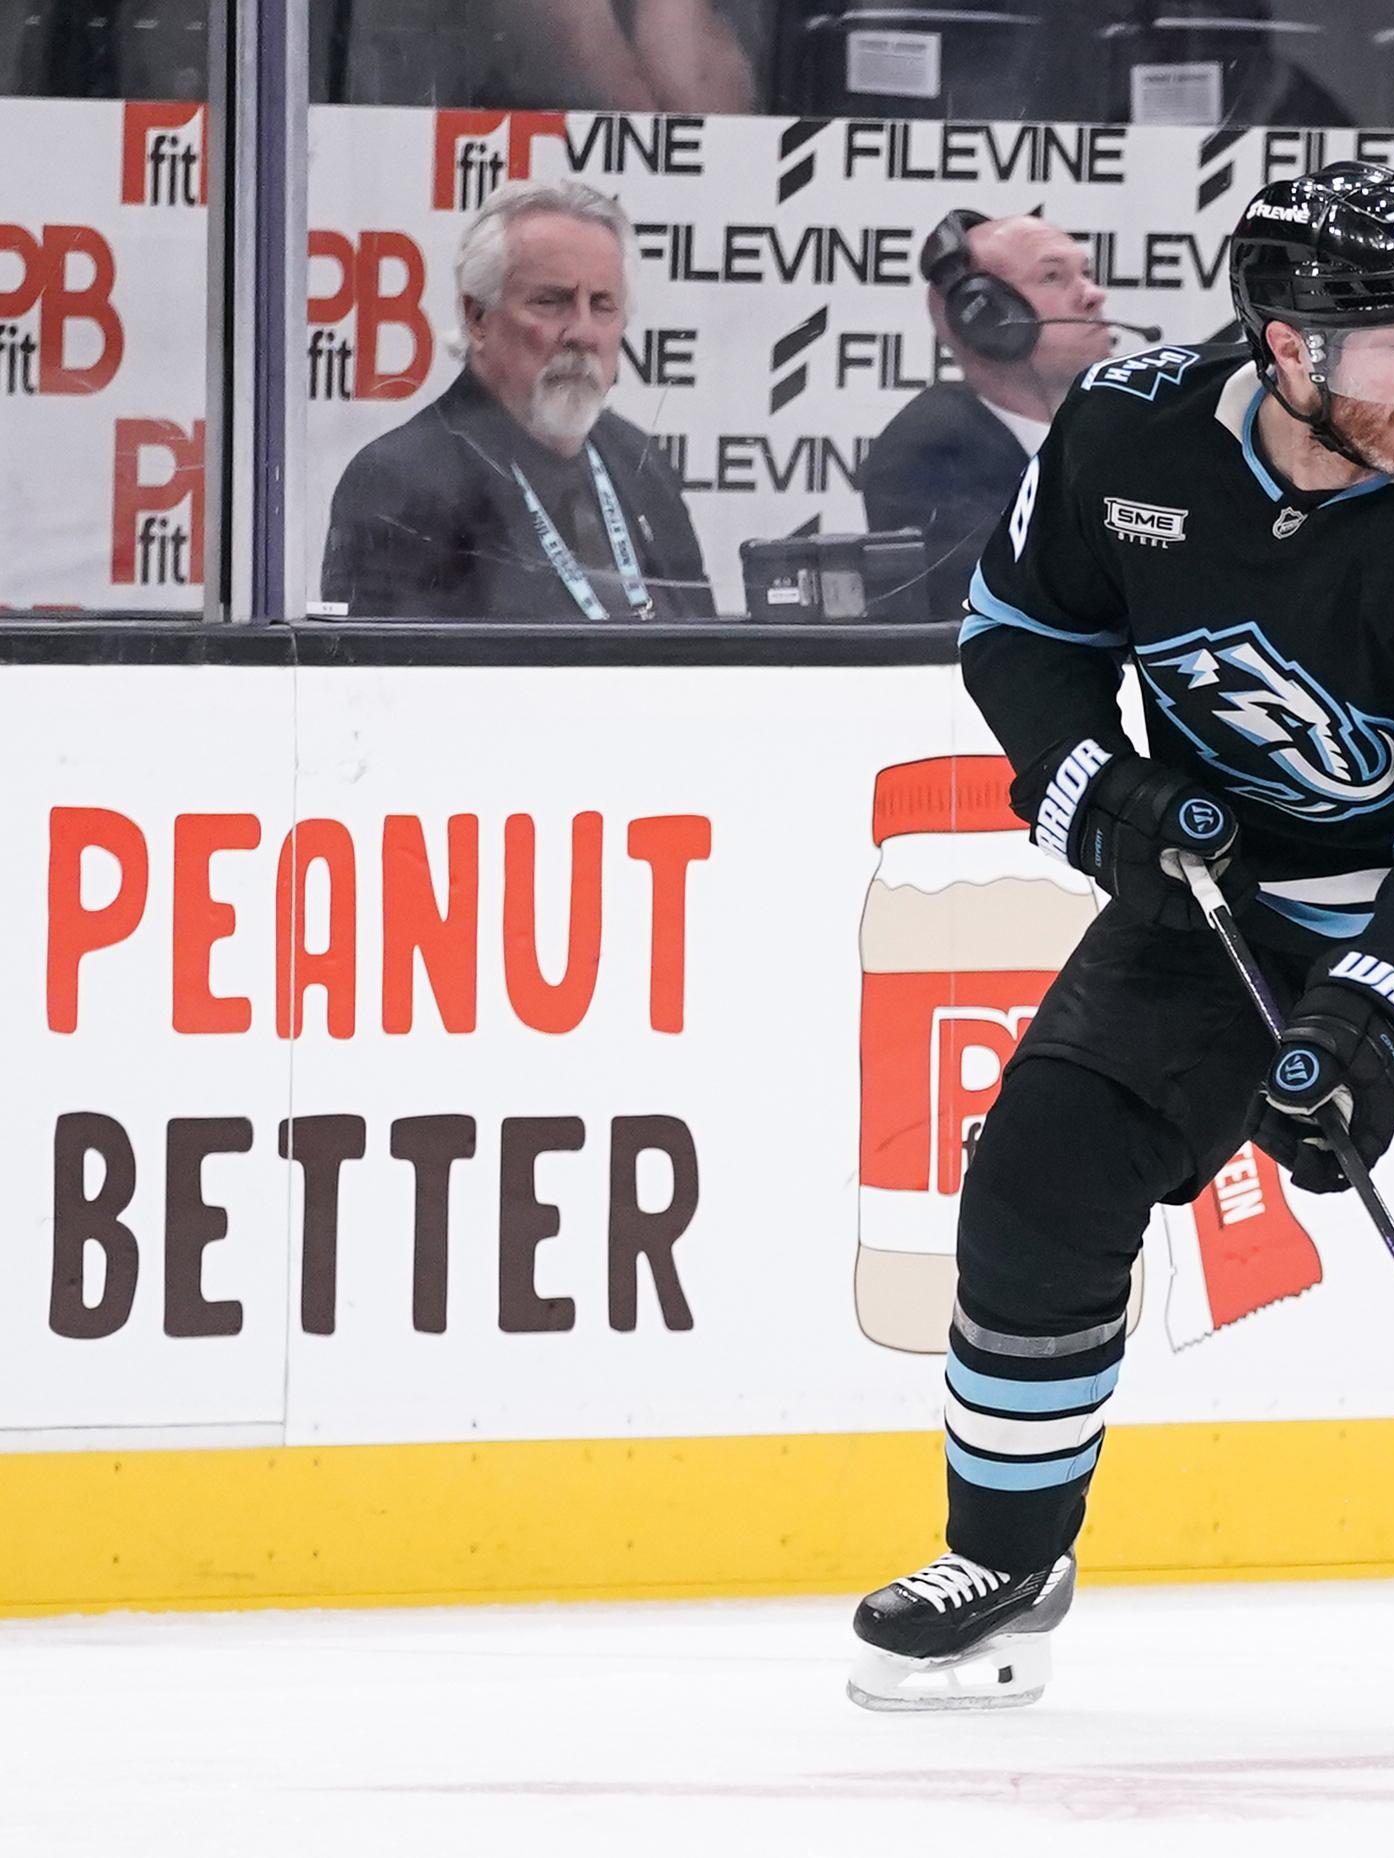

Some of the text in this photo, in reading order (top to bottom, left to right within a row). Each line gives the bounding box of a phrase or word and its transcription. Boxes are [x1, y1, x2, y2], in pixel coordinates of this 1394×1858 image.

[565, 114, 704, 173] VINE
[844, 123, 1126, 183] FILEVINE
[1007, 454, 1040, 563] 8
[1117, 508, 1175, 532] SME
[1117, 531, 1169, 549] STEEL
[1036, 738, 1114, 860] RRIOR
[46, 806, 712, 1041] PEANUT
[48, 1111, 700, 1341] BETTER
